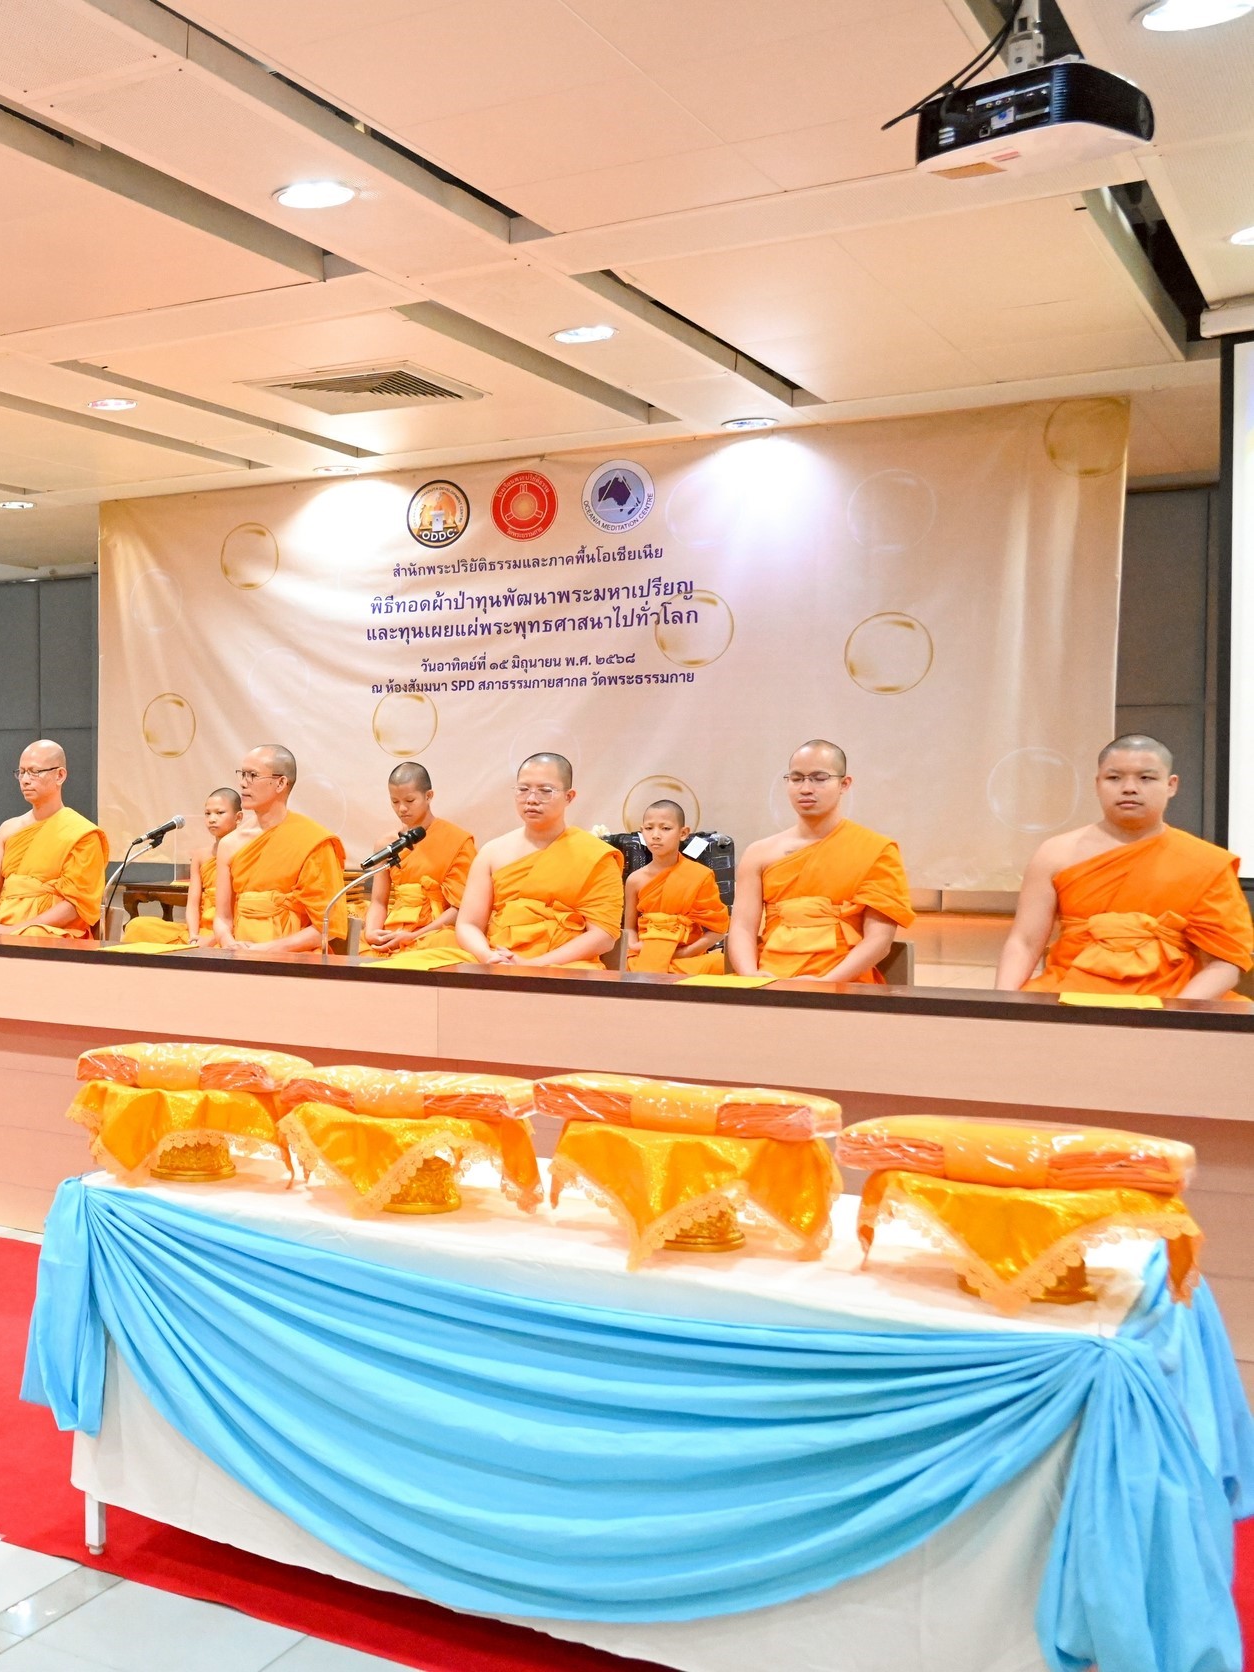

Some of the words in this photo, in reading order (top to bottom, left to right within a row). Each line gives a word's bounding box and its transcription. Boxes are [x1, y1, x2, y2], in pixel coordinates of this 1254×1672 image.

[583, 500, 601, 526] OCEANIA
[600, 517, 639, 531] MEDITATION
[638, 493, 654, 519] CENTRE
[421, 528, 455, 541] ODDC
[392, 543, 663, 578] สำนักพระปริยัติธรรมและภาคพื้นโอเชียเนีย
[370, 576, 694, 614] พิธีทอดผ้าป่าทุนพัฒนาพระมหาเปรียญ
[366, 600, 699, 645] และทุนเผยแผ่พระพุทธศาสนาไปทั่วโลก
[420, 651, 487, 673] วันอาทิตย์ที่
[489, 659, 509, 671] ๑๕
[511, 654, 562, 673] มิถุนายน
[564, 654, 592, 667] พ.ศ.
[595, 652, 636, 665] ๒๕๖๘
[371, 683, 383, 694] ณ
[385, 678, 448, 694] ห้องสัมมนา
[451, 680, 475, 692] SPD
[477, 675, 588, 691] สภาธรรมกายสากล
[590, 671, 695, 687] วัดพระธรรมกาย
